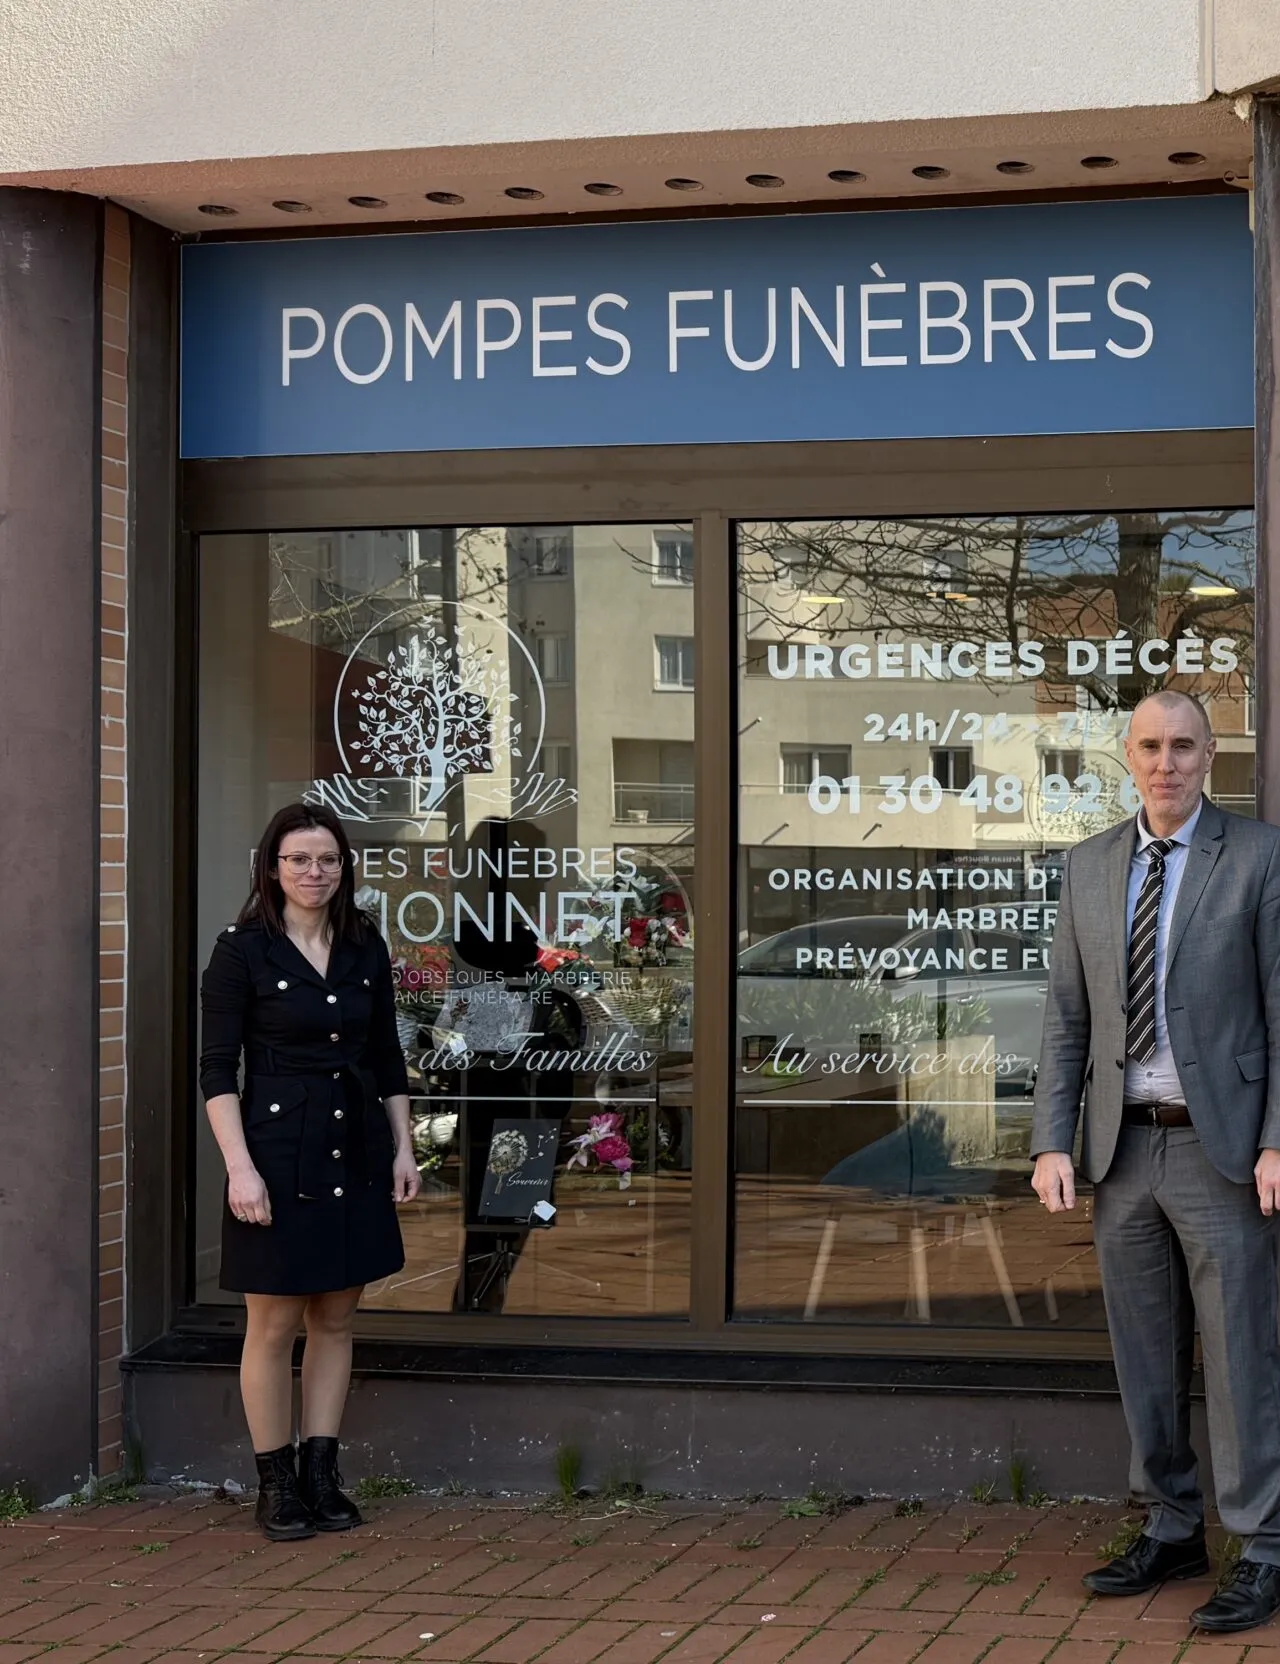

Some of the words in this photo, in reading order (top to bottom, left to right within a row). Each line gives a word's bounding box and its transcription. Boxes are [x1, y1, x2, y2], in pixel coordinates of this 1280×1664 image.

[281, 292, 632, 386] POMPES
[668, 261, 1154, 373] FUNÈBRES
[767, 640, 1046, 680] URGENCES
[1067, 627, 1240, 676] DÉCÈS
[863, 709, 1009, 746] 24h/24
[807, 774, 861, 815] 01
[877, 775, 944, 815] 30
[957, 774, 1024, 814] 48
[1041, 773, 1104, 813] 92
[1119, 774, 1145, 813] 6
[424, 840, 637, 879] FUNÈBRES
[768, 868, 1014, 891] ORGANISATION
[380, 890, 637, 944] IONNET
[907, 908, 1058, 931] MARBRER
[796, 942, 1009, 971] PRÉVOYANCE
[418, 1034, 482, 1072] des
[490, 1031, 659, 1072] Familles
[742, 1032, 818, 1074] Au
[821, 1044, 950, 1075] service
[951, 1034, 1032, 1075] des
